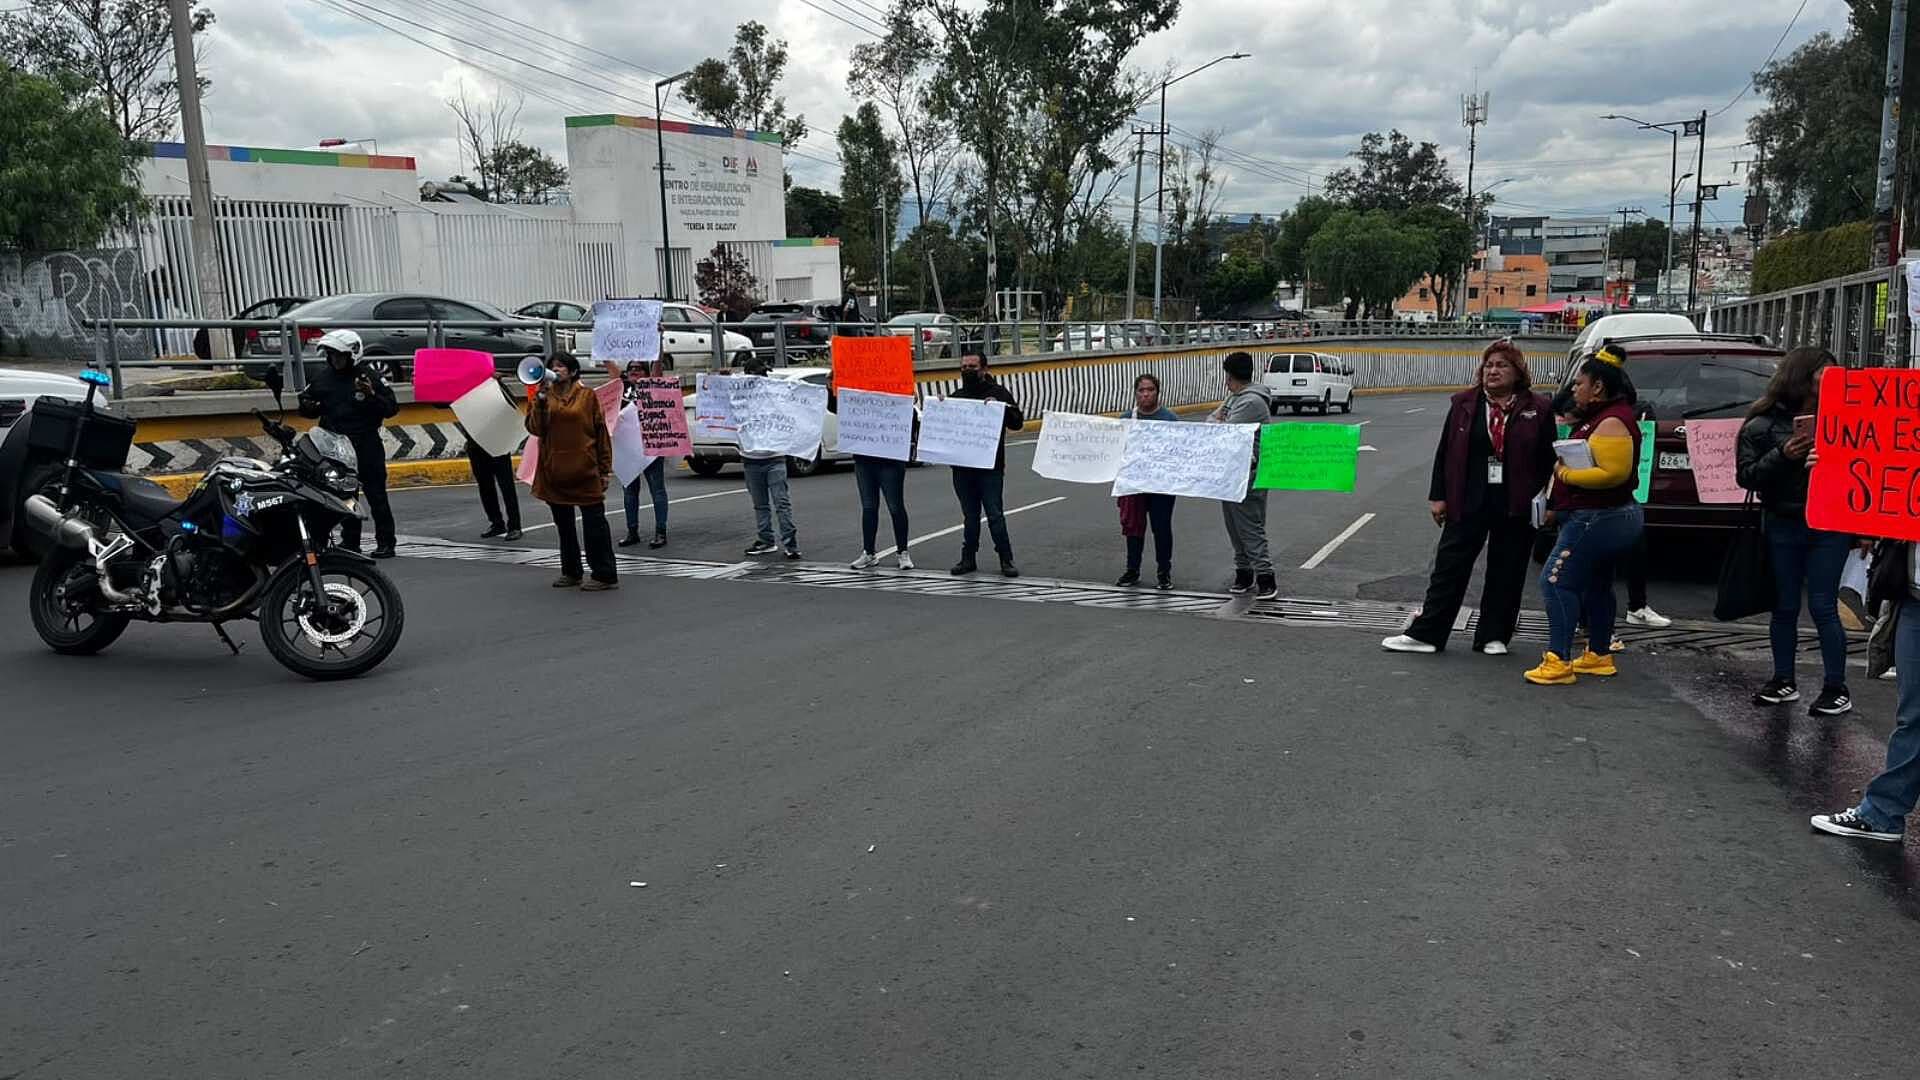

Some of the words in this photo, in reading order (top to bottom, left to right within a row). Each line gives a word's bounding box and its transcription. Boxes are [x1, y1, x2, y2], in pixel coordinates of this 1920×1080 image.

[663, 180, 689, 190] ENTRO
[690, 181, 699, 191] DE
[671, 194, 677, 204] E
[706, 223, 714, 231] DE
[1823, 415, 1881, 453] UNA
[257, 496, 284, 510] M567
